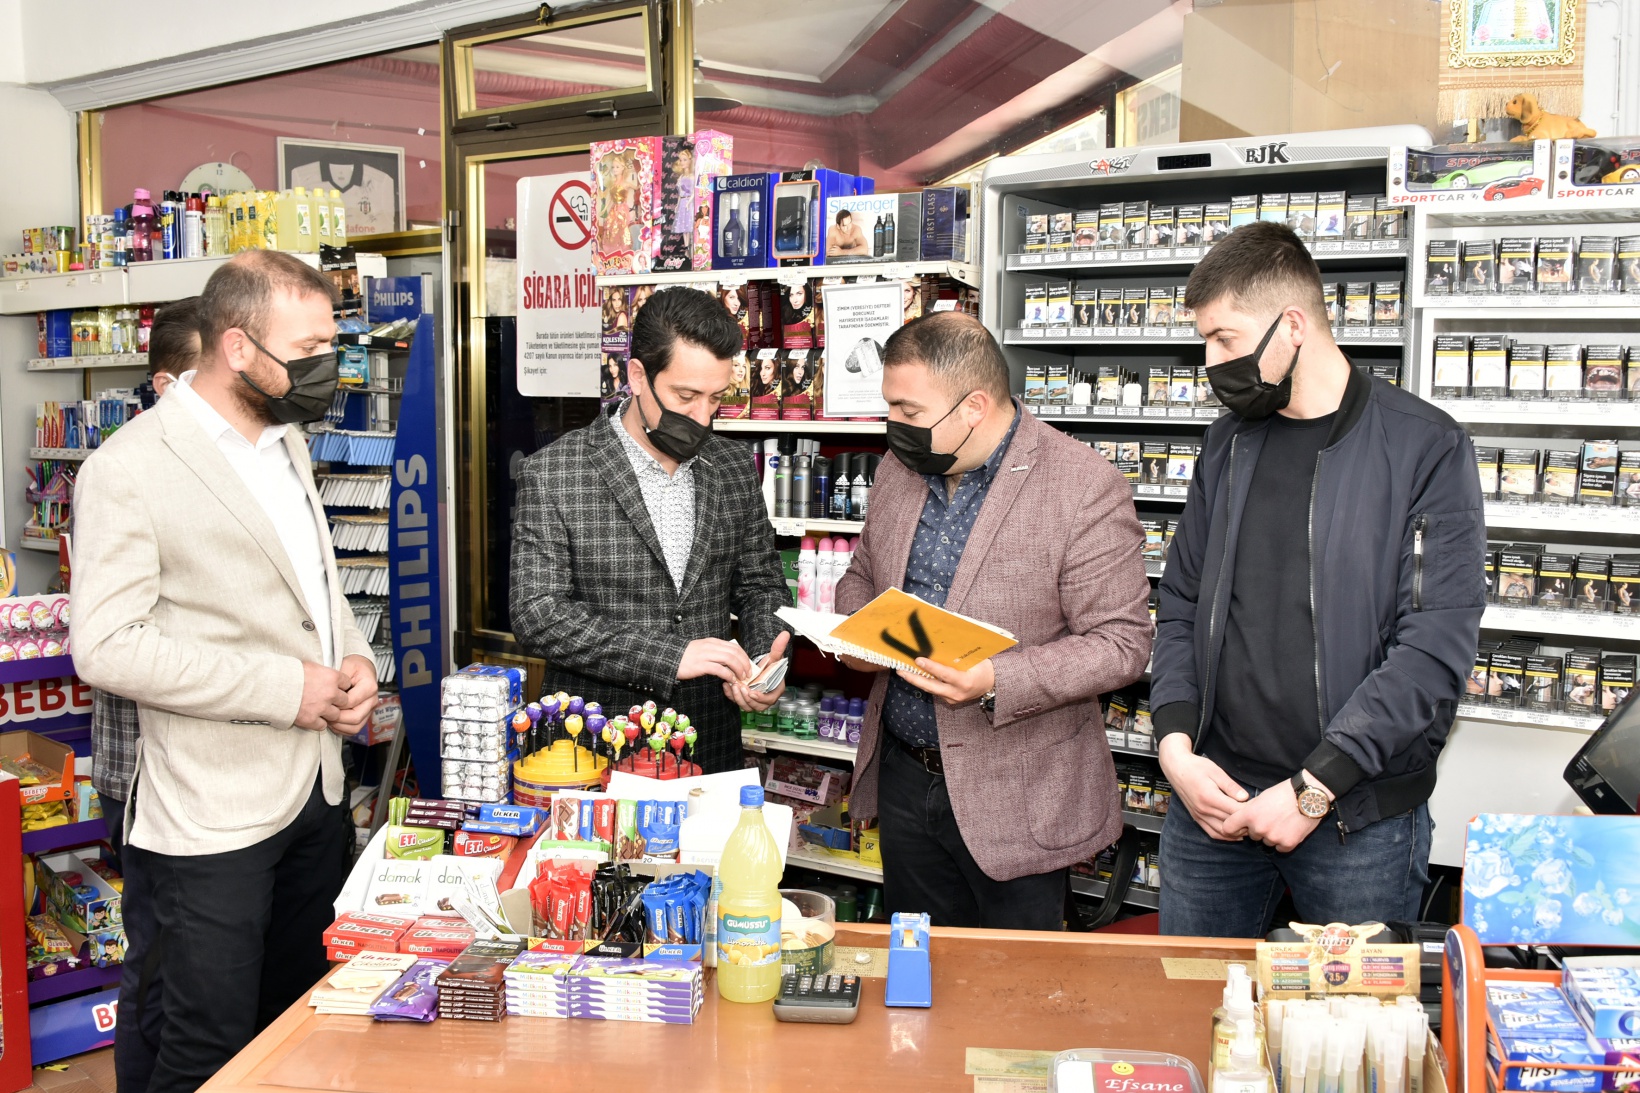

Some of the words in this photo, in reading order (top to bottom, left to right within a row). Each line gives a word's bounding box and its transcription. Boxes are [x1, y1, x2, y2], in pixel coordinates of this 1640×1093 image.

[1245, 142, 1290, 165] BJK
[727, 178, 763, 189] caldion
[1392, 192, 1465, 204] SPORTCAR
[1556, 187, 1635, 198] SPORTCAR
[829, 199, 895, 214] Slazenger
[927, 193, 936, 215] CLASS
[926, 214, 935, 240] FIRST
[523, 270, 572, 310] SİGARA
[374, 291, 414, 306] PHILIPS
[396, 452, 433, 689] PHILIPS
[24, 788, 48, 796] BEBETO
[492, 808, 520, 818] ÜLKER
[378, 866, 422, 884] damak
[337, 921, 395, 936] ÜLKER
[413, 929, 471, 940] ÜLKER
[331, 937, 355, 946] ÜLKER
[542, 943, 565, 951] ÜLKER
[727, 936, 768, 947] Limonata
[408, 944, 433, 953] ÜLKER
[599, 944, 622, 953] ÜLKER
[659, 948, 682, 956] ÜLKER
[522, 951, 559, 960] Milka
[616, 988, 642, 996] Milkinis
[1487, 989, 1529, 1001] First
[523, 1008, 548, 1016] Milkinis
[616, 1005, 642, 1013] Milkinis
[616, 1013, 642, 1021] Milkinis
[1501, 1012, 1542, 1023] First
[1104, 1078, 1184, 1092] Efsane
[1550, 1077, 1596, 1088] SENSATIONS
